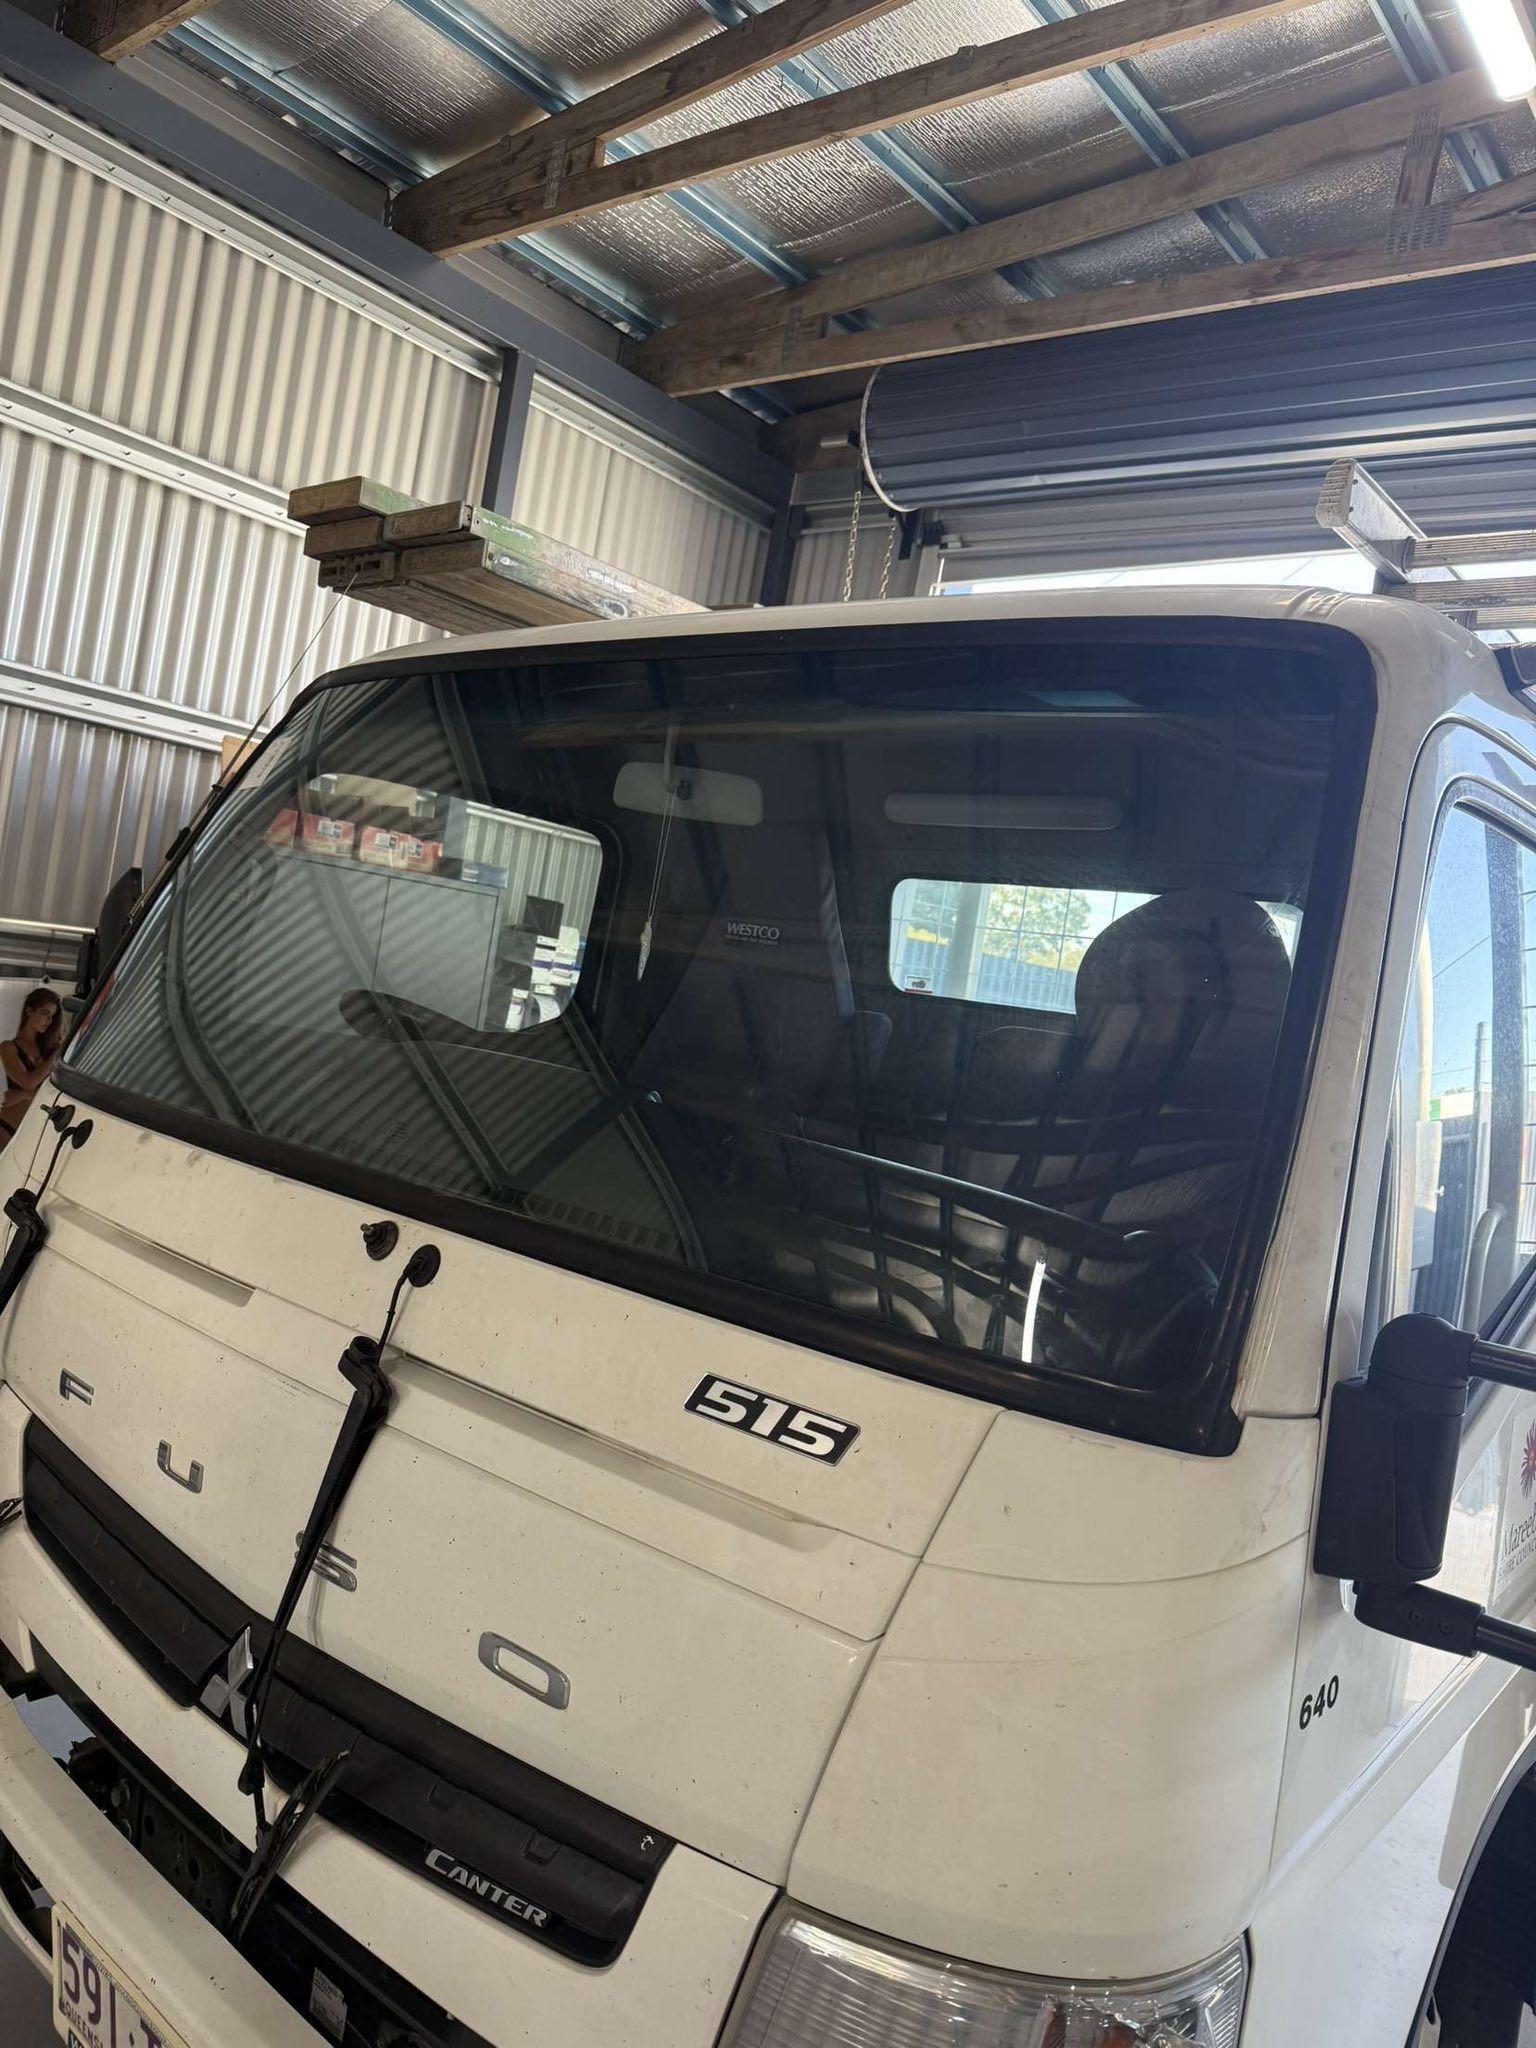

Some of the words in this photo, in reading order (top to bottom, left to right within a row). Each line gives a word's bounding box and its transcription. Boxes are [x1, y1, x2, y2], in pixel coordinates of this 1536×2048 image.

[727, 922, 780, 940] WESTCO
[696, 1381, 847, 1456] 515
[1300, 1675, 1339, 1730] 640
[425, 1849, 547, 1927] CANTER
